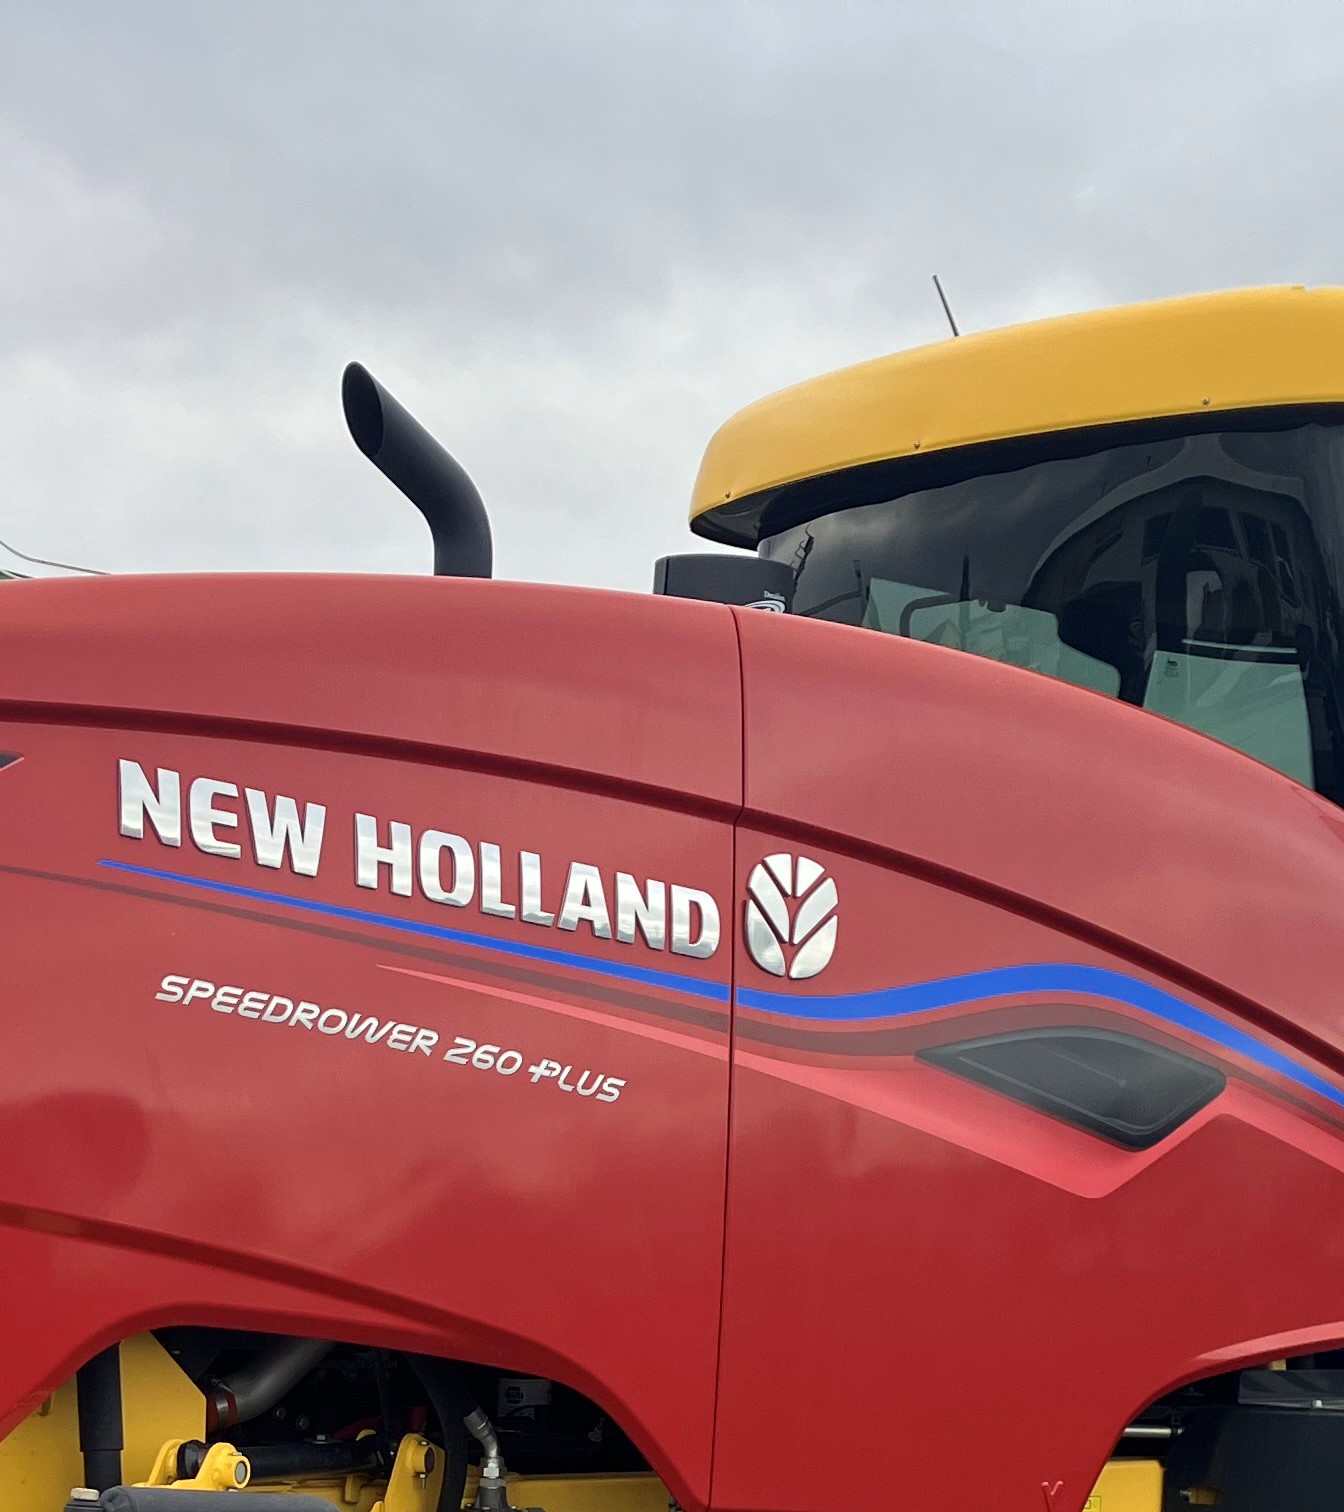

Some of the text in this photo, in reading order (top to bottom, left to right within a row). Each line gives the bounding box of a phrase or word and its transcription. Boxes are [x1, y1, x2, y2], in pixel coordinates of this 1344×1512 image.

[118, 758, 721, 960] NEW HOLLAND
[155, 975, 439, 1056] SPEEDROWER
[443, 1036, 524, 1076] 260
